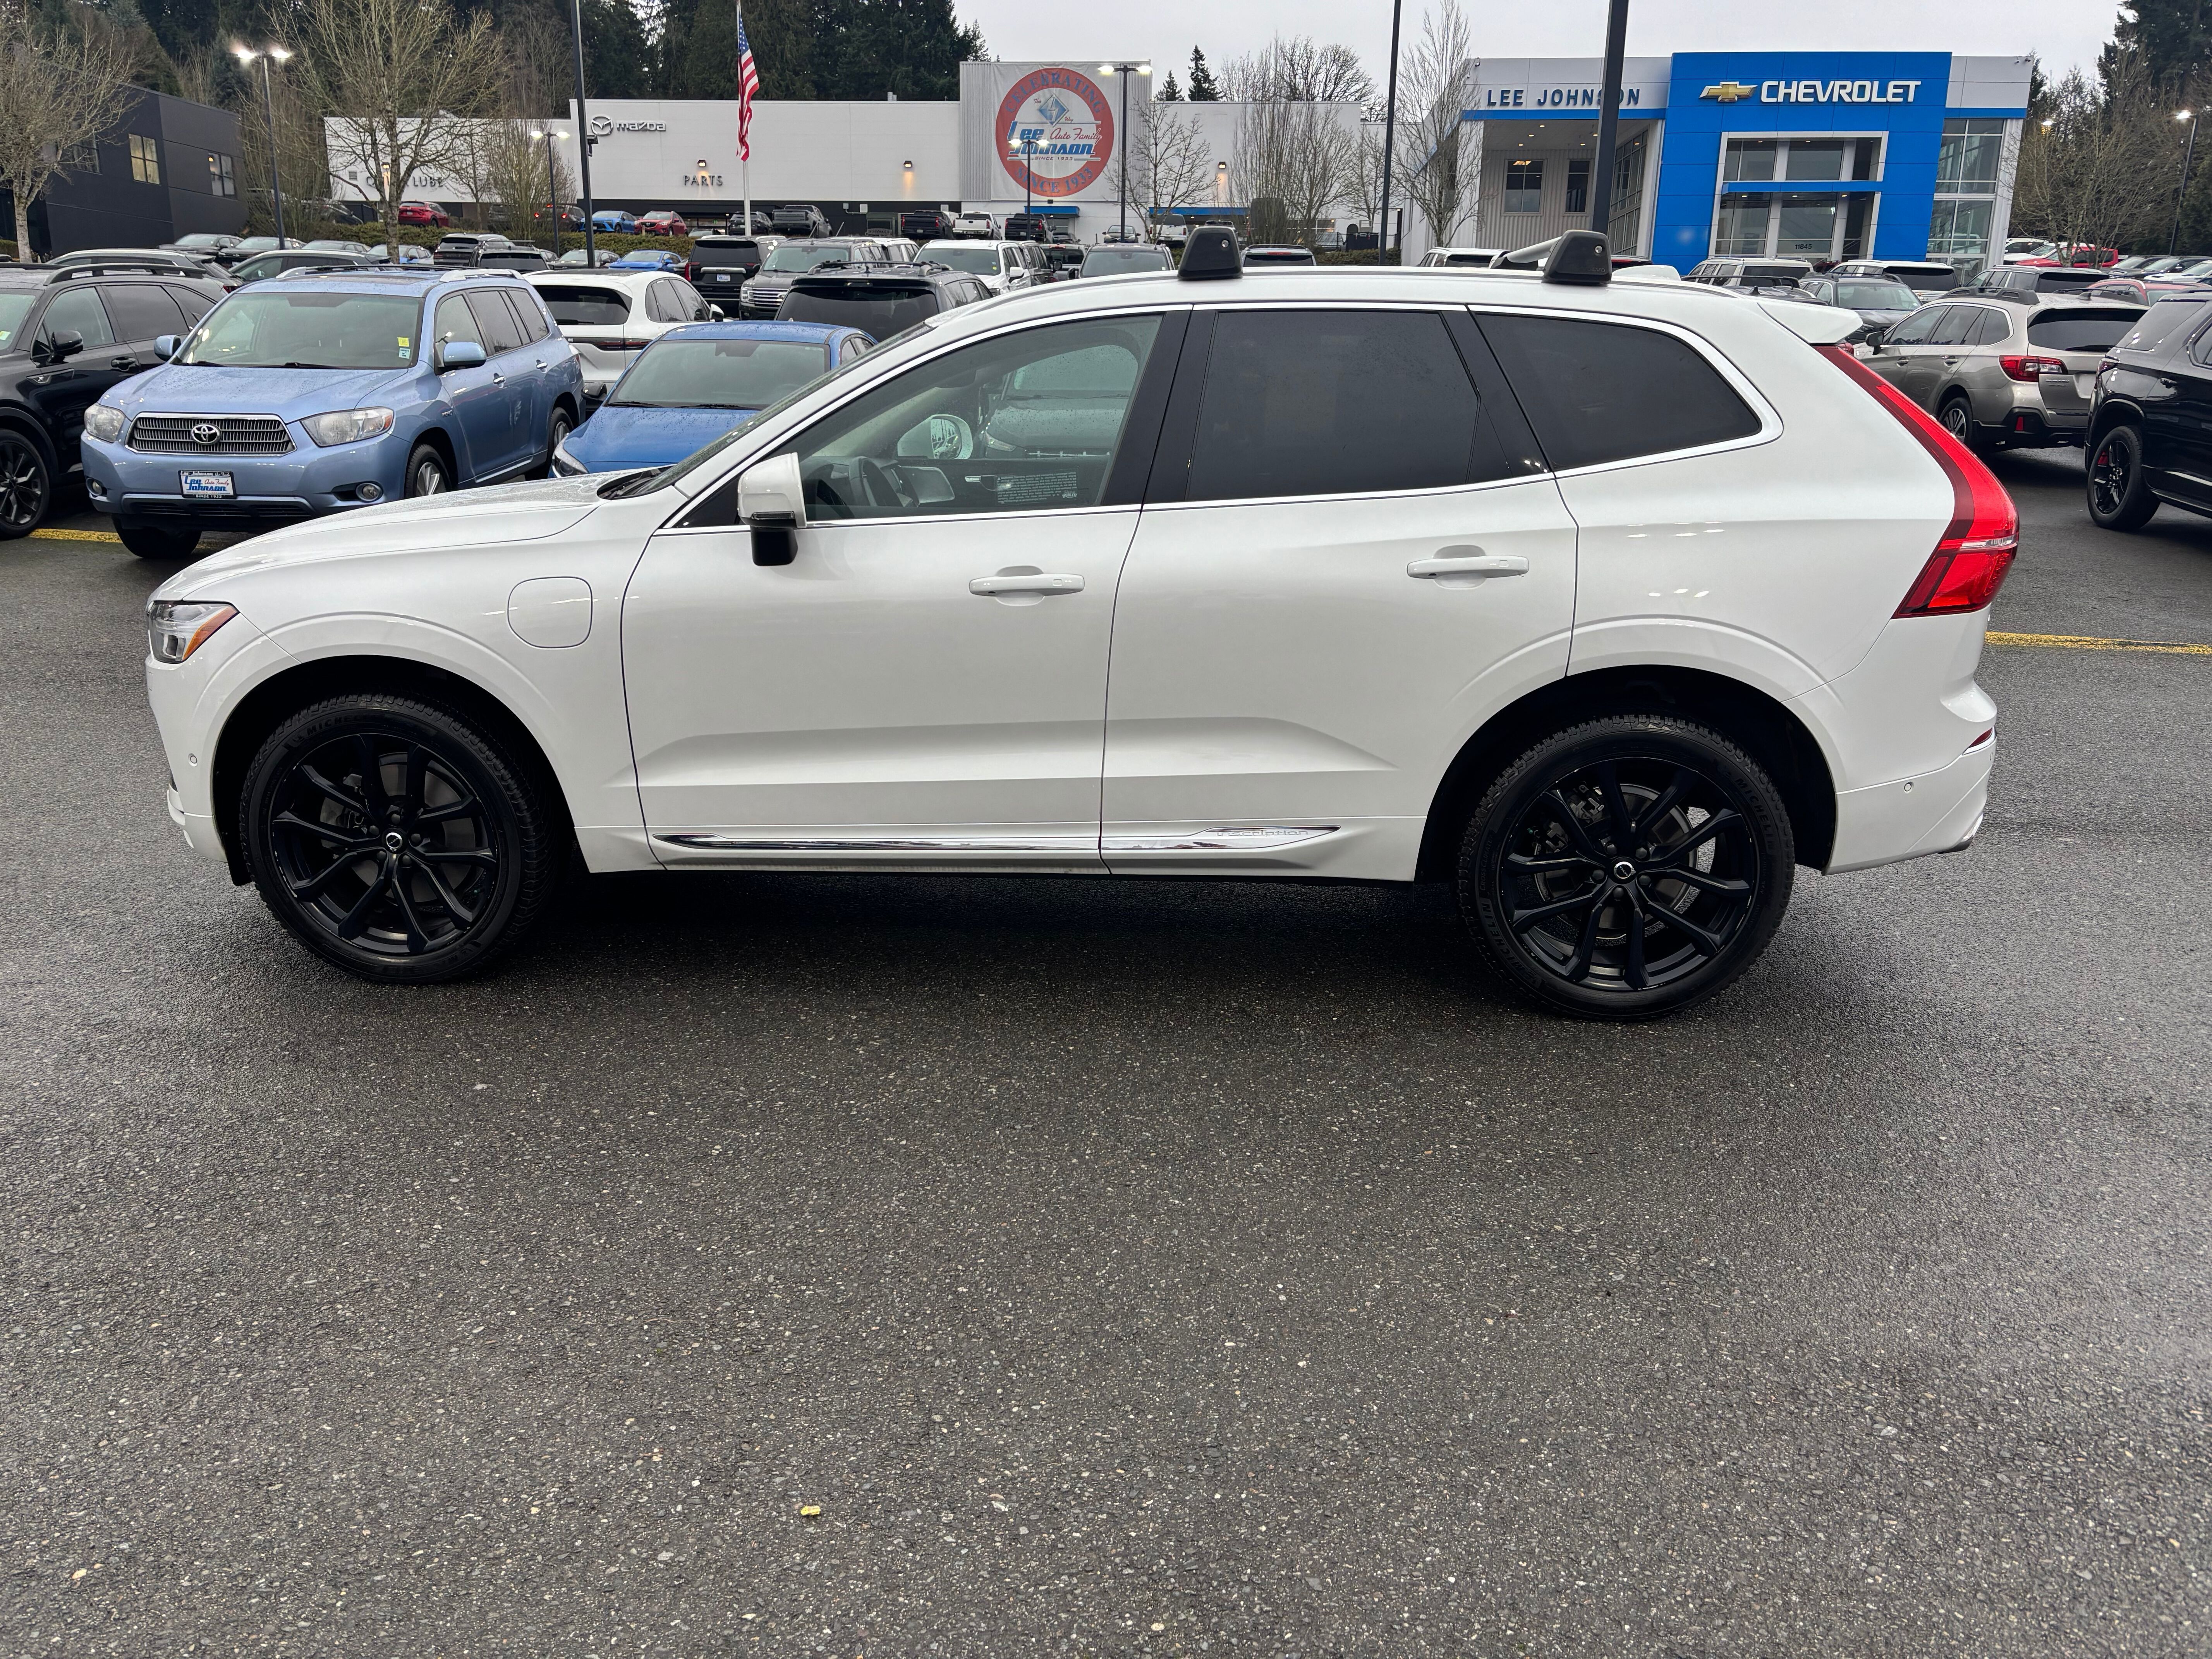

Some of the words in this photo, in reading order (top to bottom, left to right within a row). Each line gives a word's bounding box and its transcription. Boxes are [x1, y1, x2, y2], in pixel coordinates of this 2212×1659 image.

[1005, 72, 1105, 113] CELEBRATING
[1487, 89, 1524, 106] LEE
[1761, 81, 1921, 102] CHEVROLET
[1008, 121, 1044, 140] Lee
[1050, 128, 1071, 140] Auto
[1073, 128, 1102, 145] Family
[413, 177, 443, 187] LUBE
[684, 175, 723, 186] PARTS
[1066, 167, 1093, 191] 1933
